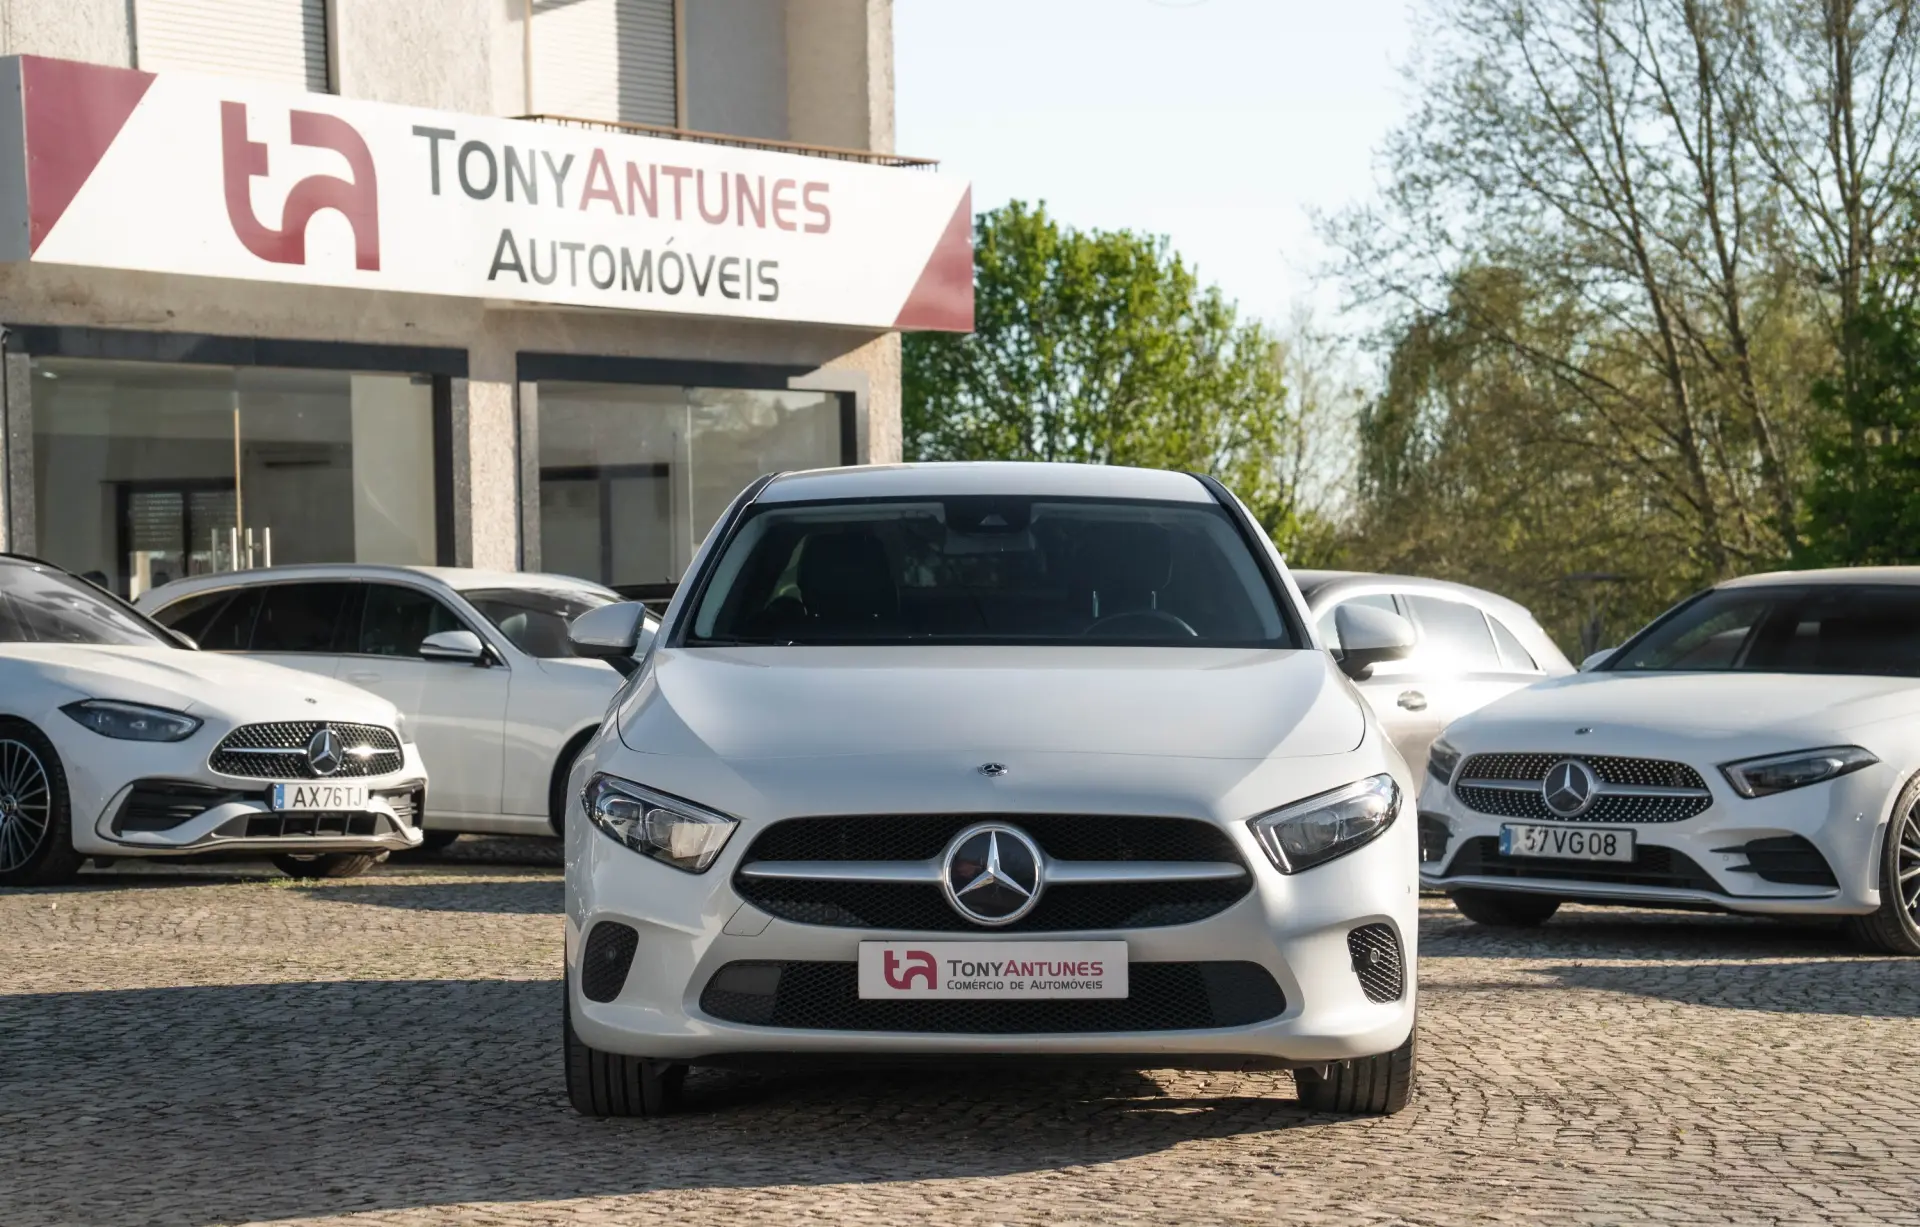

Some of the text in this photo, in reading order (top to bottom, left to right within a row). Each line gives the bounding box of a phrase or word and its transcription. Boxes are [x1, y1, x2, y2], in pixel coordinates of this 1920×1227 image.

[487, 227, 780, 303] AUTOMÓVEIS
[946, 978, 1104, 990] COMÉRCIO DE AUTOMÓVEIS
